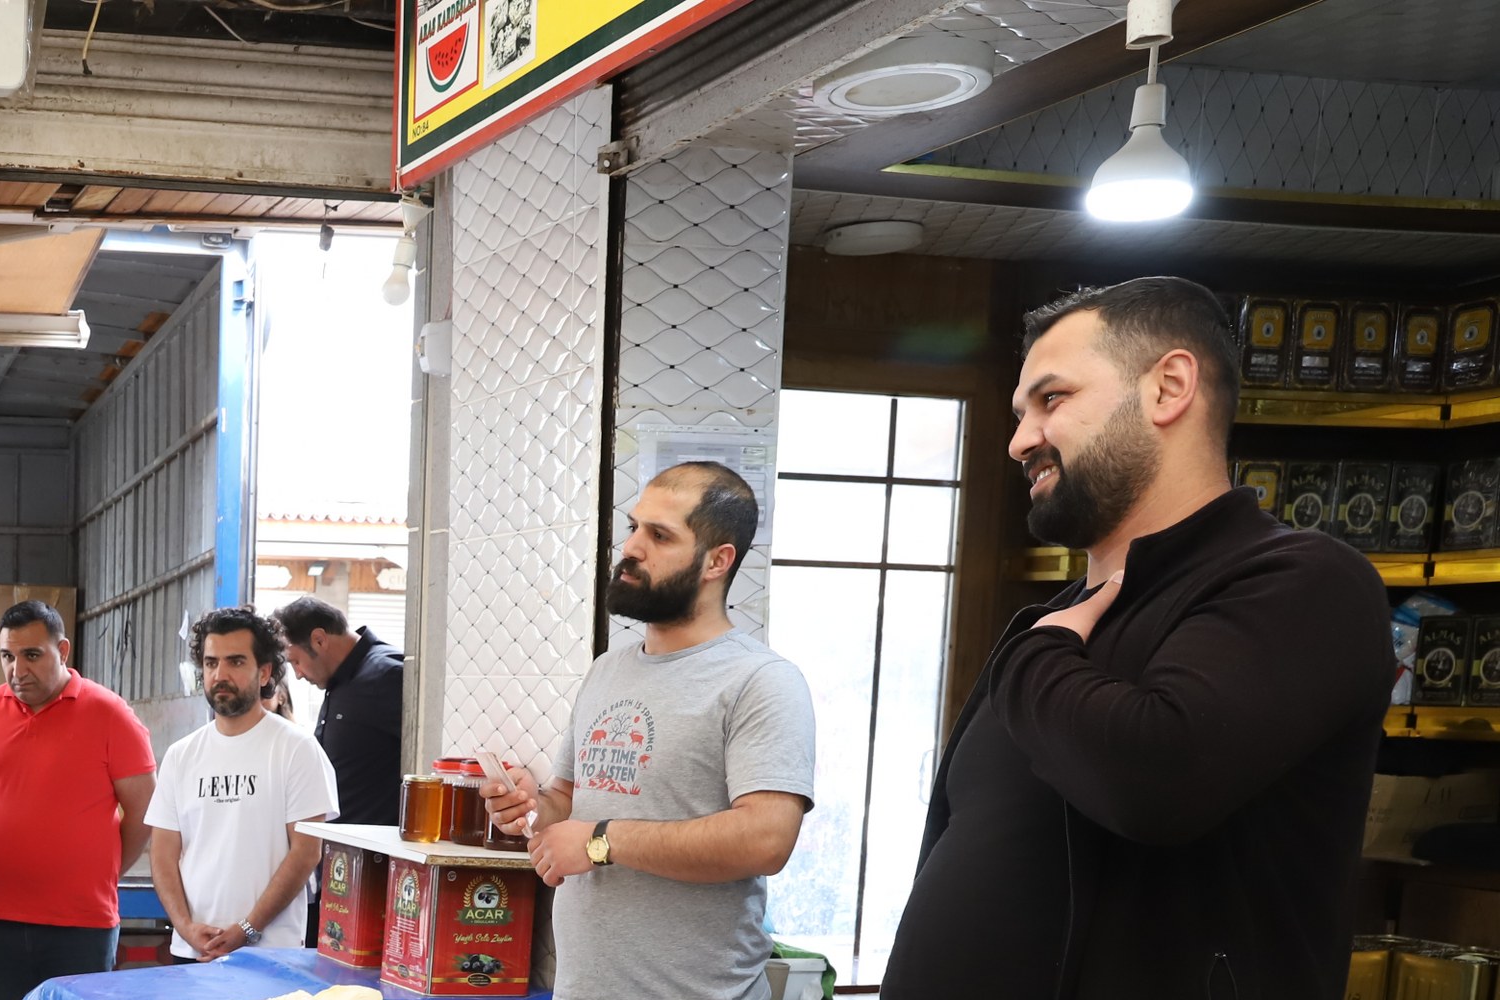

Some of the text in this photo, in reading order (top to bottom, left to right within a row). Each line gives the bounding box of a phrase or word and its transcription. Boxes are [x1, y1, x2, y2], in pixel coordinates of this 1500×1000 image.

[610, 699, 634, 712] EARTH
[634, 700, 642, 710] IS
[641, 706, 656, 752] SPEAKING
[587, 747, 638, 766] IT'S TIME
[581, 762, 637, 782] TO LISTEN
[329, 881, 346, 893] ACAR
[465, 909, 504, 920] ACAR
